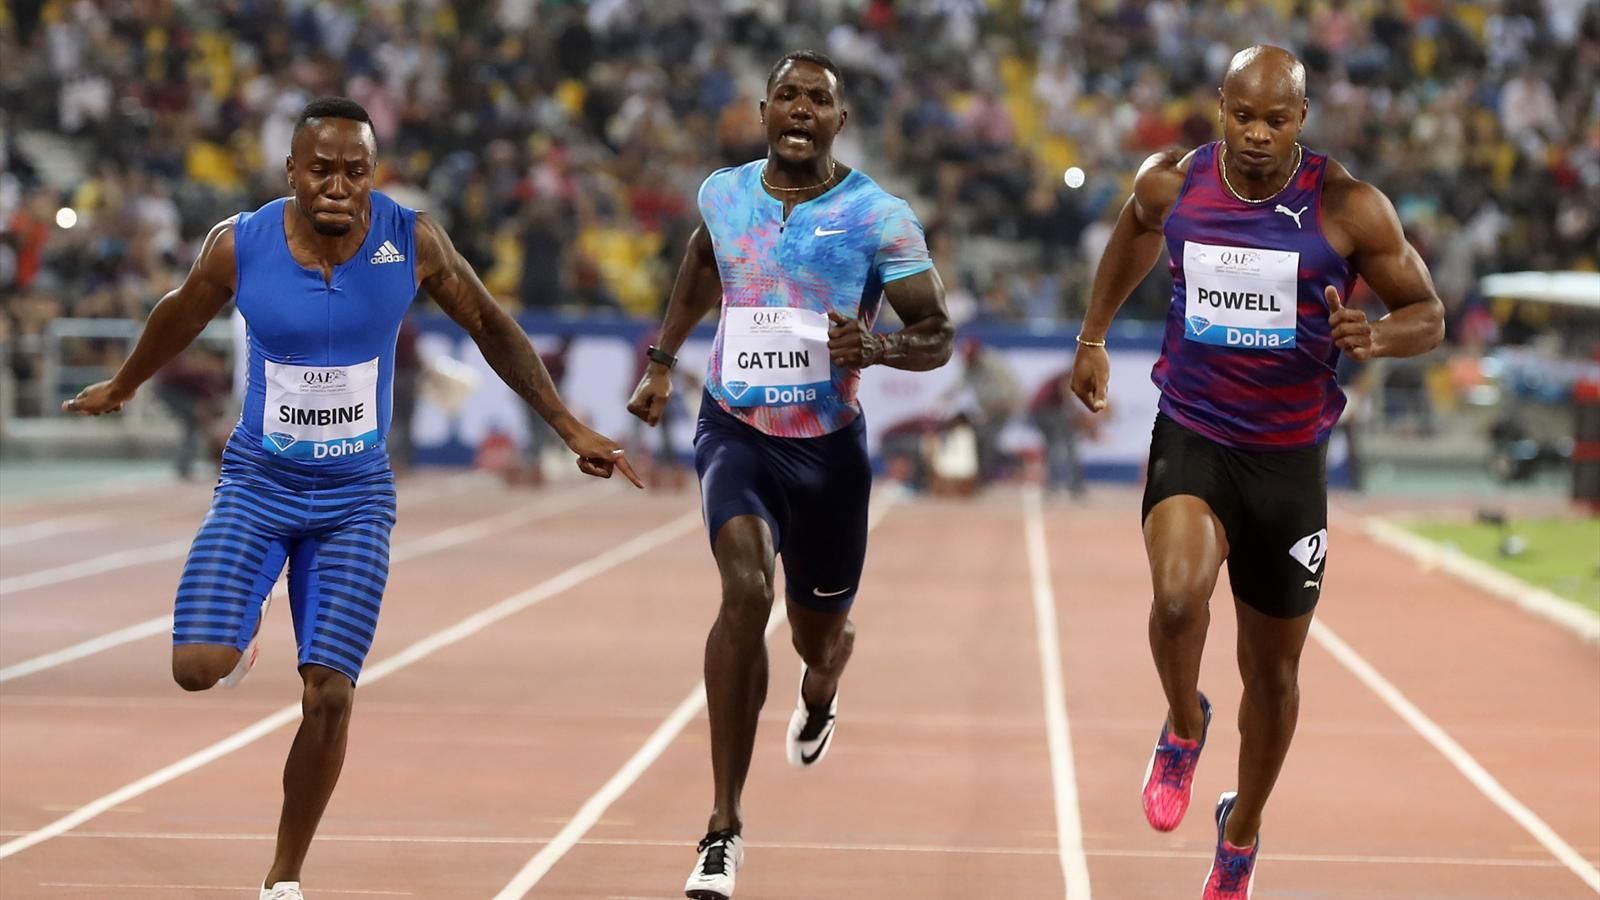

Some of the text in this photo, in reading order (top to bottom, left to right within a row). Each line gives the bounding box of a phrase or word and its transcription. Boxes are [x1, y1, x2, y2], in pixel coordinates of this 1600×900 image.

[370, 254, 405, 265] adidas
[1198, 287, 1280, 312] POWELL
[1226, 328, 1280, 346] Doha
[737, 350, 810, 369] GATLIN
[764, 387, 816, 404] Doha
[279, 402, 364, 426] SIMBINE
[313, 440, 365, 458] Doha
[1308, 534, 1321, 567] 2
